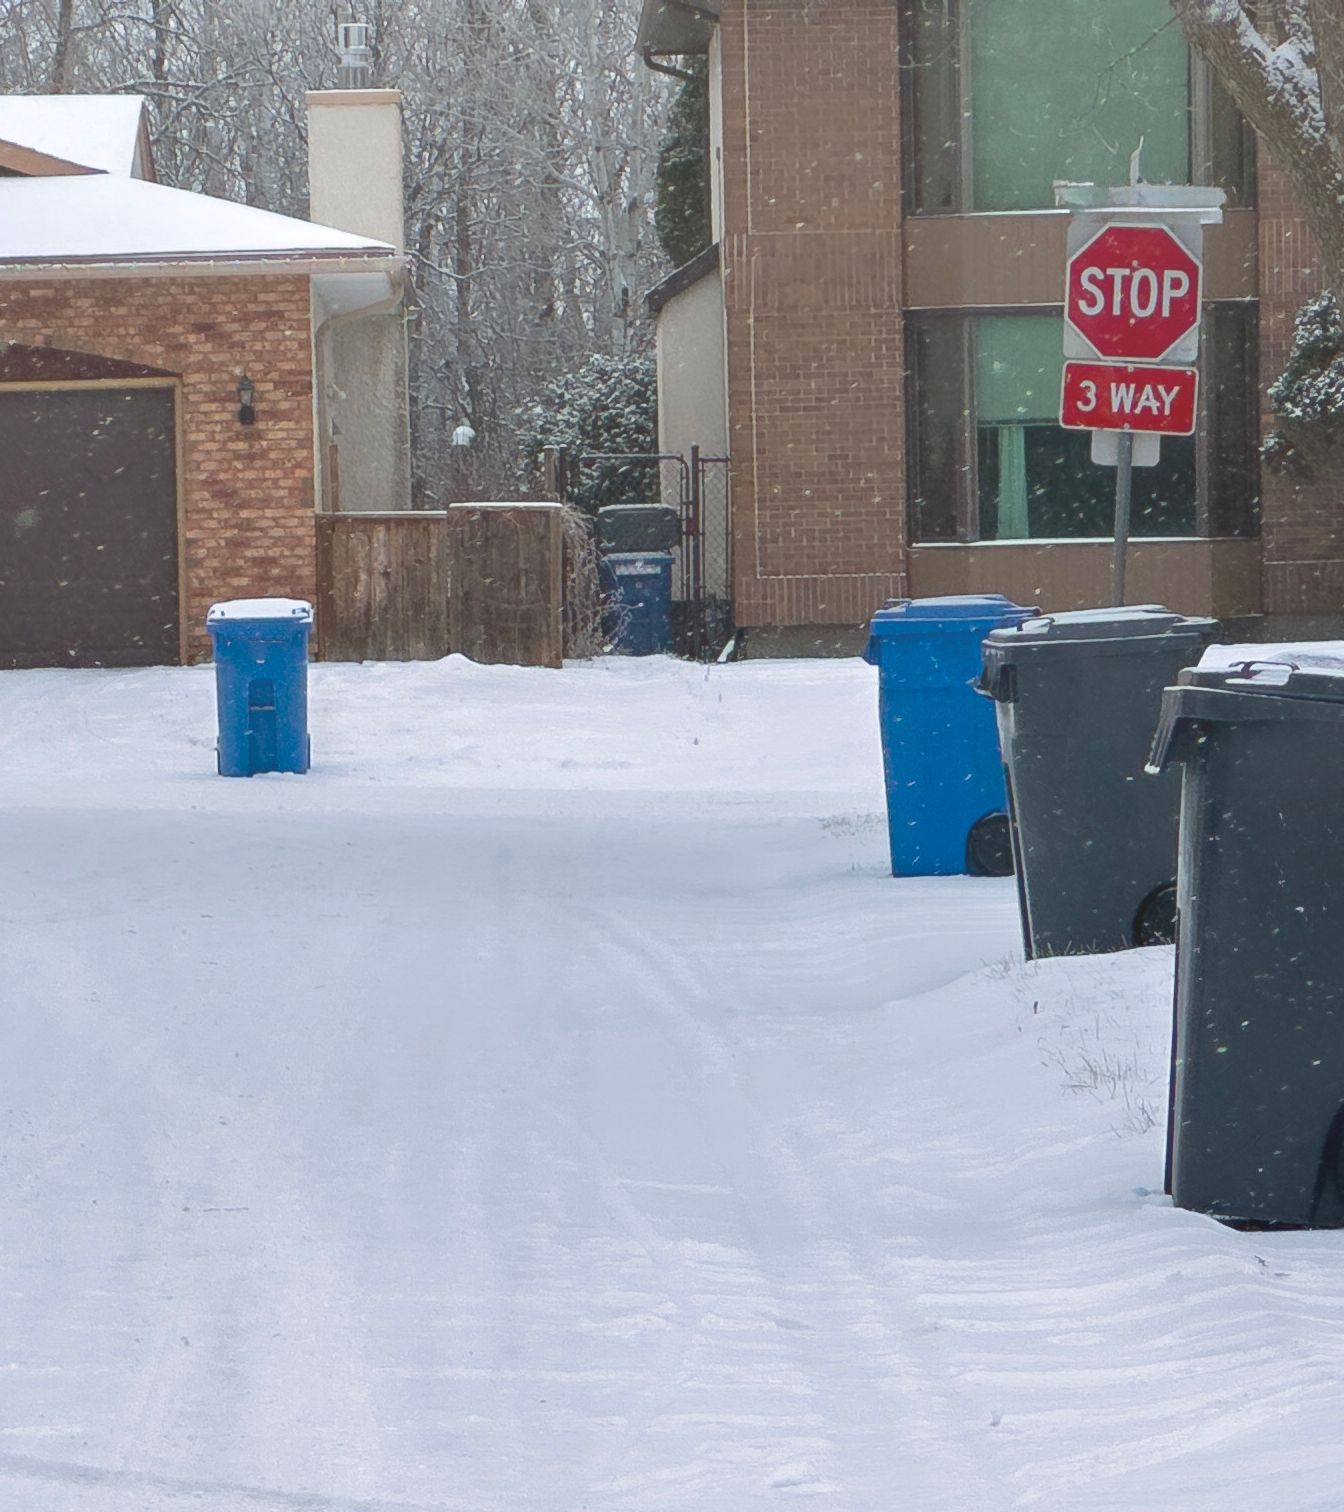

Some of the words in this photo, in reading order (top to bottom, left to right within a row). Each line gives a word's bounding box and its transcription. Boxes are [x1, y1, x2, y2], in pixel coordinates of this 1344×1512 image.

[1078, 266, 1190, 317] STOP
[1076, 380, 1097, 412] 3
[1110, 382, 1180, 416] WAY
